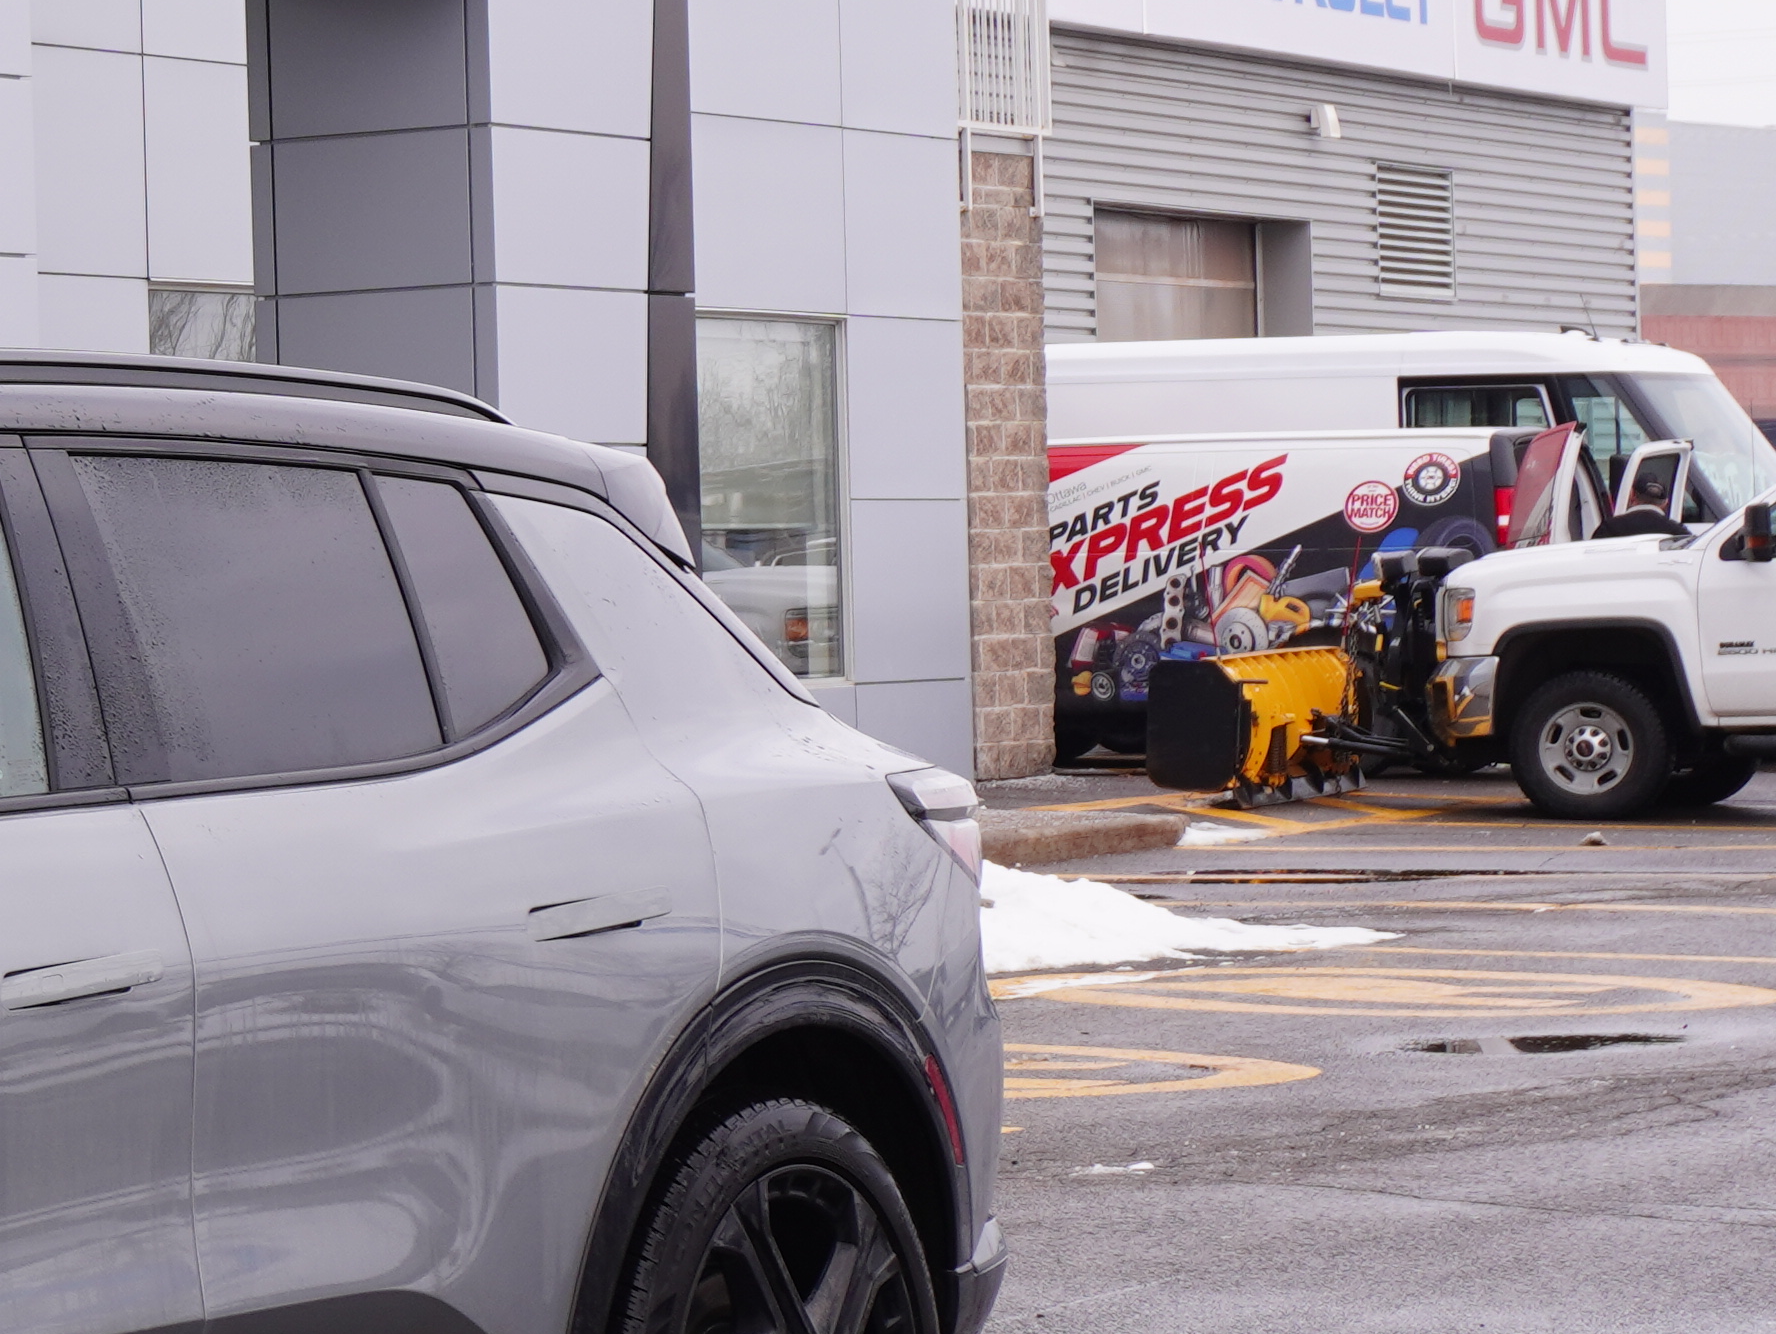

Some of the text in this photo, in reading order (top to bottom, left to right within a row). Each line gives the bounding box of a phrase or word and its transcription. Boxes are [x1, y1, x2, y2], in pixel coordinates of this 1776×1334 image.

[1047, 481, 1087, 505] Ottawa
[1049, 480, 1161, 551] PARTS
[1350, 493, 1393, 507] PRICE
[1350, 506, 1391, 519] MATCH
[1049, 453, 1288, 597] XPRESS
[1073, 514, 1250, 615] DELIVERY
